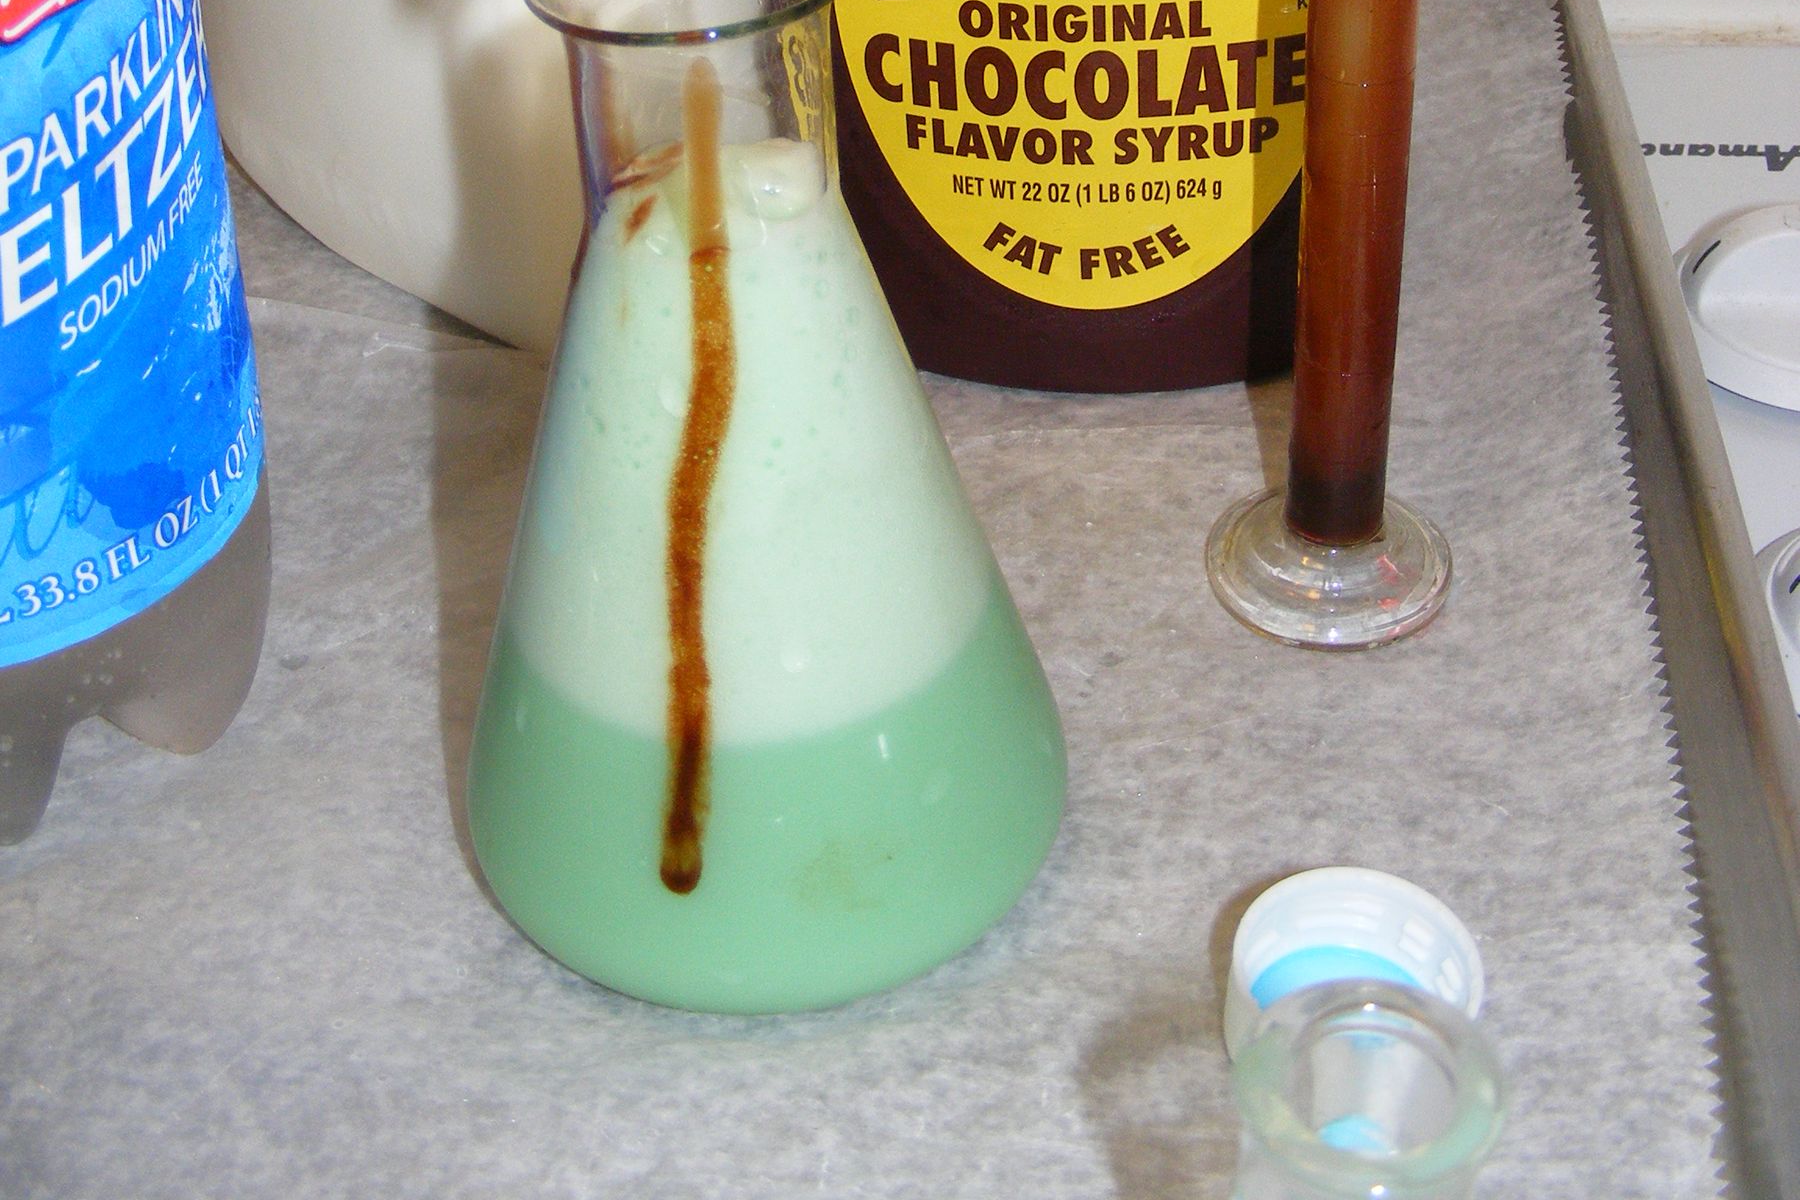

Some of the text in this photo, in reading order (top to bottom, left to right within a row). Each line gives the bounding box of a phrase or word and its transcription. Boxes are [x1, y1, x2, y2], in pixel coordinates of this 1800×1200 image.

[958, 0, 1211, 43] ORIGINAL
[864, 32, 1306, 120] CHOCOLATE
[905, 113, 1280, 165] FLAVOR SYRUP
[953, 174, 1222, 208] NET WT 22 OZ (1 LB 6 OZ) 624 g
[60, 151, 204, 350] SODIUM FREE
[982, 221, 1191, 280] FAT FREE
[16, 560, 99, 616] 33.8
[105, 535, 150, 581] FL
[154, 495, 199, 549] OZ
[200, 469, 222, 513] (1
[225, 424, 250, 481] QT
